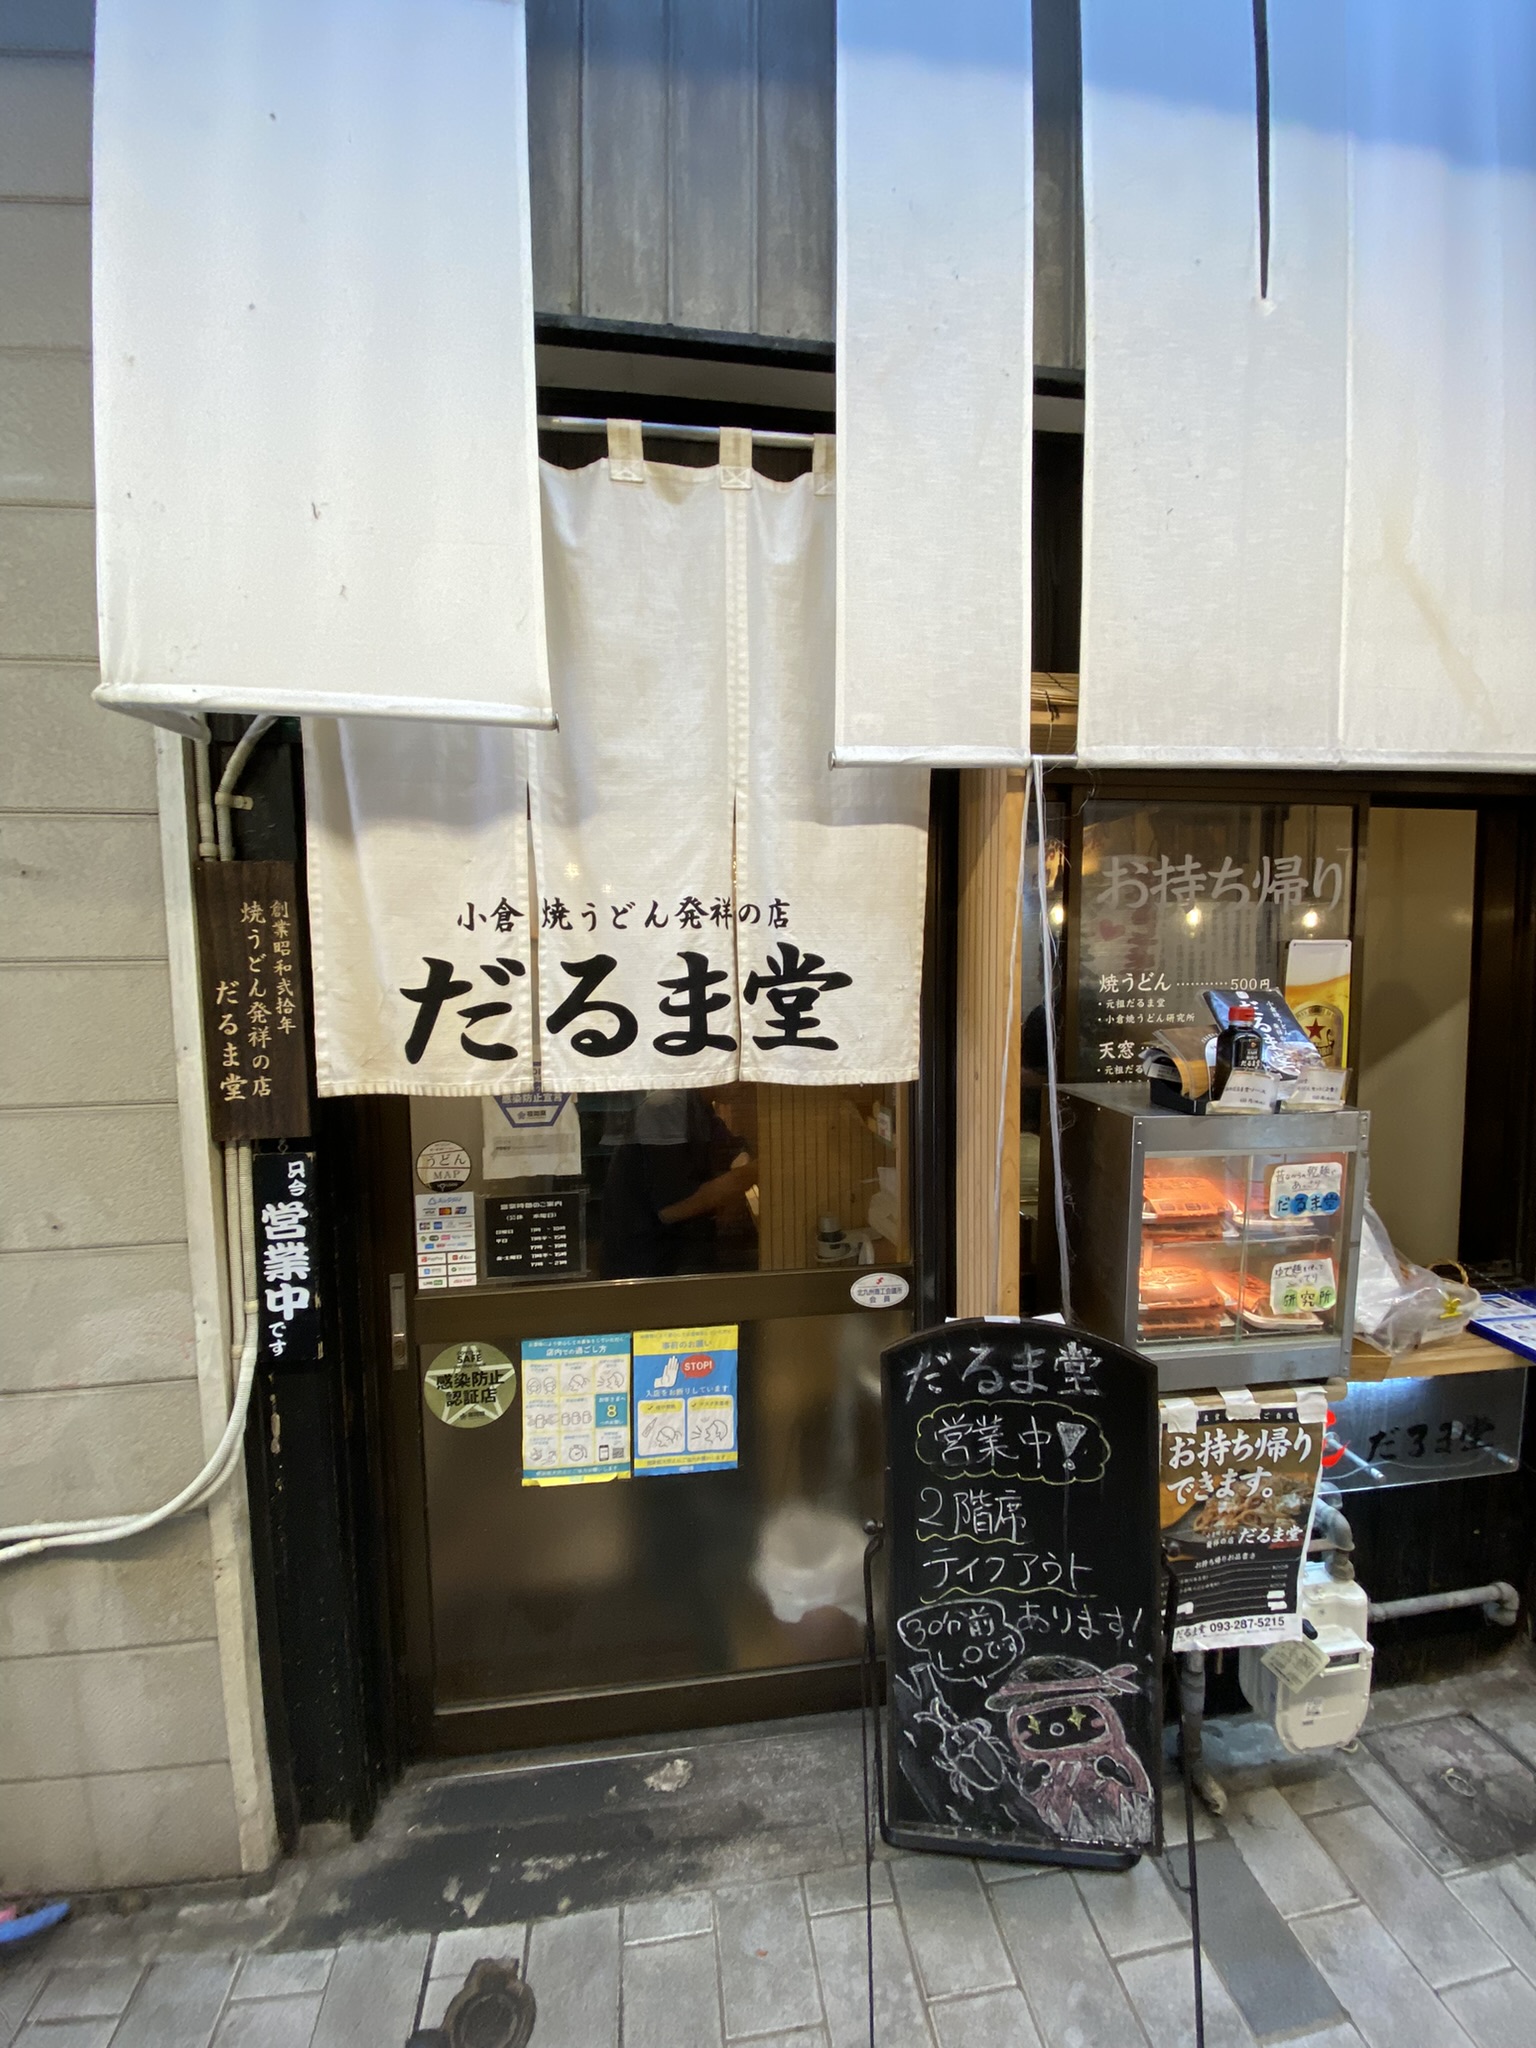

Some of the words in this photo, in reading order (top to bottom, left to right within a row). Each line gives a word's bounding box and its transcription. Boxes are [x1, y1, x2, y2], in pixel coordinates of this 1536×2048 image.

[1096, 853, 1343, 912] お持ち帰り
[1099, 972, 1172, 993] 焼うどん
[1230, 978, 1270, 990] 500円
[240, 901, 272, 1098] 焼うどん発祥の店
[399, 942, 853, 1065] だるま堂
[215, 979, 247, 1102] だるま堂
[1099, 1040, 1135, 1060] 天窓
[427, 1153, 466, 1167] うどん
[287, 1160, 307, 1197] 只今
[433, 1170, 461, 1179] MAP
[1277, 1194, 1339, 1212] だるま堂
[261, 1200, 311, 1321] 営業中
[1283, 1290, 1332, 1307] 研究所
[268, 1322, 287, 1357] です
[457, 1353, 482, 1364] SAFE
[684, 1360, 713, 1371] STOP!
[437, 1371, 505, 1390] 感染防止
[903, 1340, 1104, 1404] だるま堂
[446, 1388, 497, 1407] 認証店
[607, 1405, 617, 1418] 8
[1169, 1426, 1312, 1469] お持ち帰り
[1167, 1466, 1273, 1504] できます。
[917, 1487, 1026, 1544] 2階席
[1238, 1525, 1303, 1544] だるま堂
[923, 1548, 1093, 1591] テイクアウト
[1176, 1624, 1206, 1639] だるま堂
[1209, 1617, 1285, 1633] 093-287-5215
